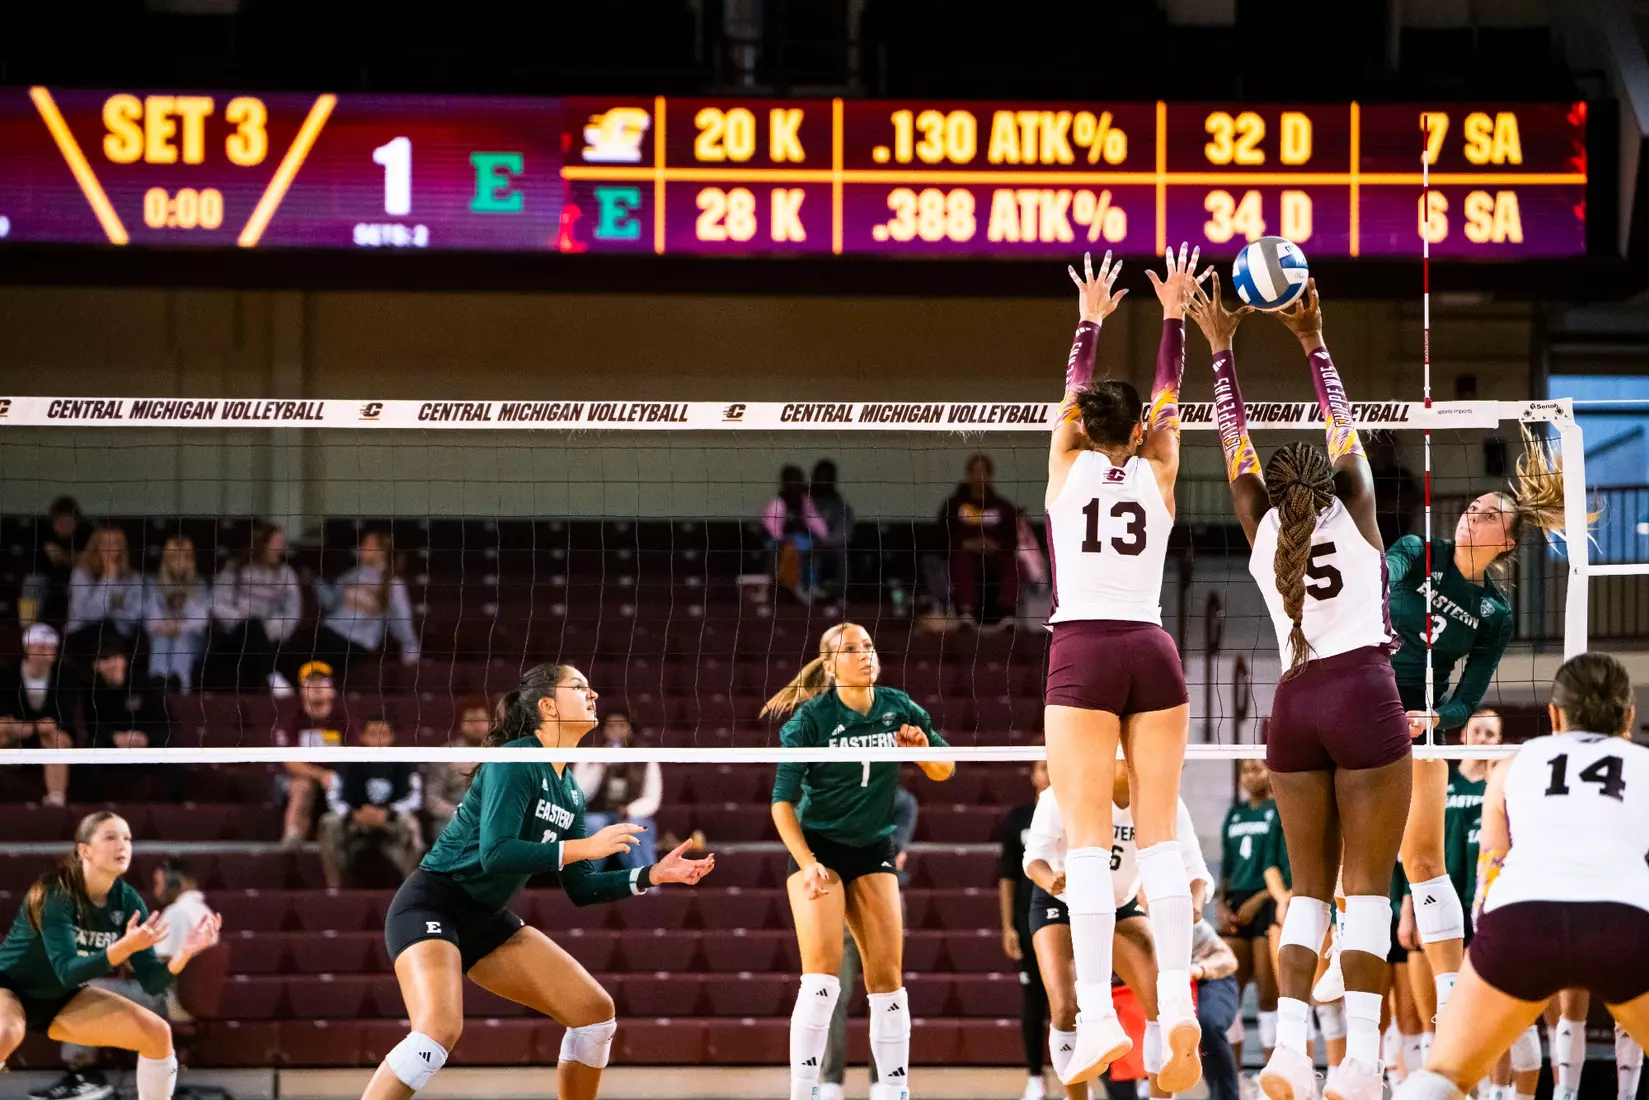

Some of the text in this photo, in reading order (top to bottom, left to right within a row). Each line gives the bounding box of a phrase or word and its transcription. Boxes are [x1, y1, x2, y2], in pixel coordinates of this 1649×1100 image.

[102, 94, 268, 165] SET 3
[695, 107, 806, 163] 20 K
[872, 110, 1128, 164] .130 ATK%
[1204, 112, 1312, 165] 32 D
[1420, 112, 1523, 165] 7 SA
[372, 136, 413, 216] 1
[470, 151, 524, 213] E
[143, 187, 224, 229] 0:00
[594, 187, 642, 240] E
[696, 187, 807, 242] 28 K
[872, 188, 1128, 243] .388 ATK%
[1203, 190, 1313, 243] 34 D
[1418, 190, 1524, 243] 6 SA
[47, 400, 324, 421] CENTRAL MICHIGAN VOLLEYBALL
[417, 402, 689, 423] CENTRAL MICHIGAN VOLLEYBALL
[780, 403, 1049, 424] CENTRAL MICHIGAN VOLLEYBALL
[1081, 497, 1147, 556] 13
[1306, 541, 1344, 601] 5
[1419, 615, 1448, 644] 3
[1544, 753, 1627, 803] 14
[535, 798, 575, 831] EASTERN
[1110, 845, 1124, 871] 6
[426, 921, 442, 934] E
[1046, 908, 1060, 920] E
